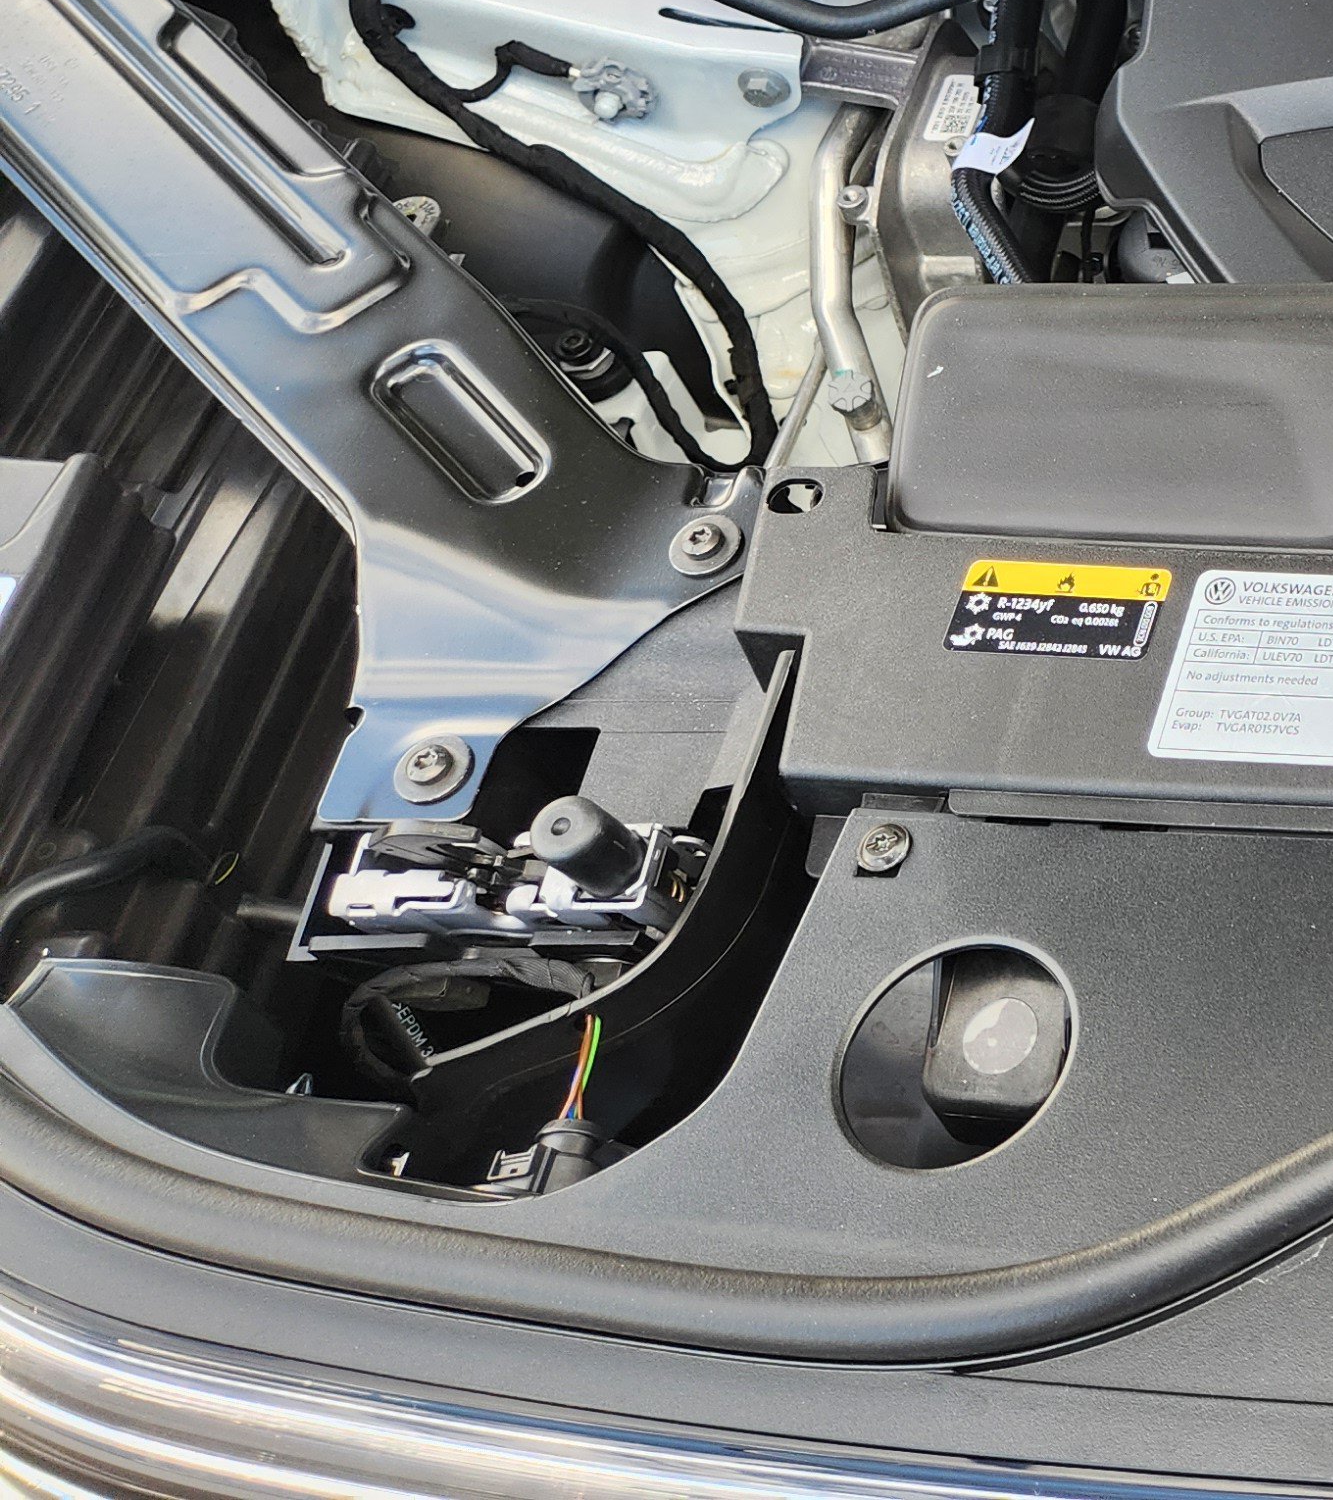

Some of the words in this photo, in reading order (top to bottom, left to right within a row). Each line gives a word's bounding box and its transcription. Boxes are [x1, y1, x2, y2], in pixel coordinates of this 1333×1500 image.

[1238, 596, 1282, 606] VEHICLE
[997, 598, 1055, 613] R-1234yf
[1079, 603, 1109, 614] 0.650
[1110, 604, 1125, 618] kg
[1203, 615, 1255, 626] Conforms
[1259, 618, 1269, 627] to
[986, 628, 1014, 640] PAG
[1199, 632, 1217, 642] U.S.
[1221, 633, 1244, 643] EPA:
[1267, 635, 1299, 645] BIN70
[998, 641, 1014, 650] SAE
[1099, 644, 1119, 656] VW
[1120, 646, 1141, 657] AG
[1193, 648, 1250, 660] California:
[1262, 652, 1302, 662] ULEV70
[1187, 670, 1202, 680] No
[1205, 672, 1274, 684] adjustments
[1277, 676, 1319, 685] needed
[1176, 707, 1214, 720] Group:
[1172, 720, 1201, 732] Evap:
